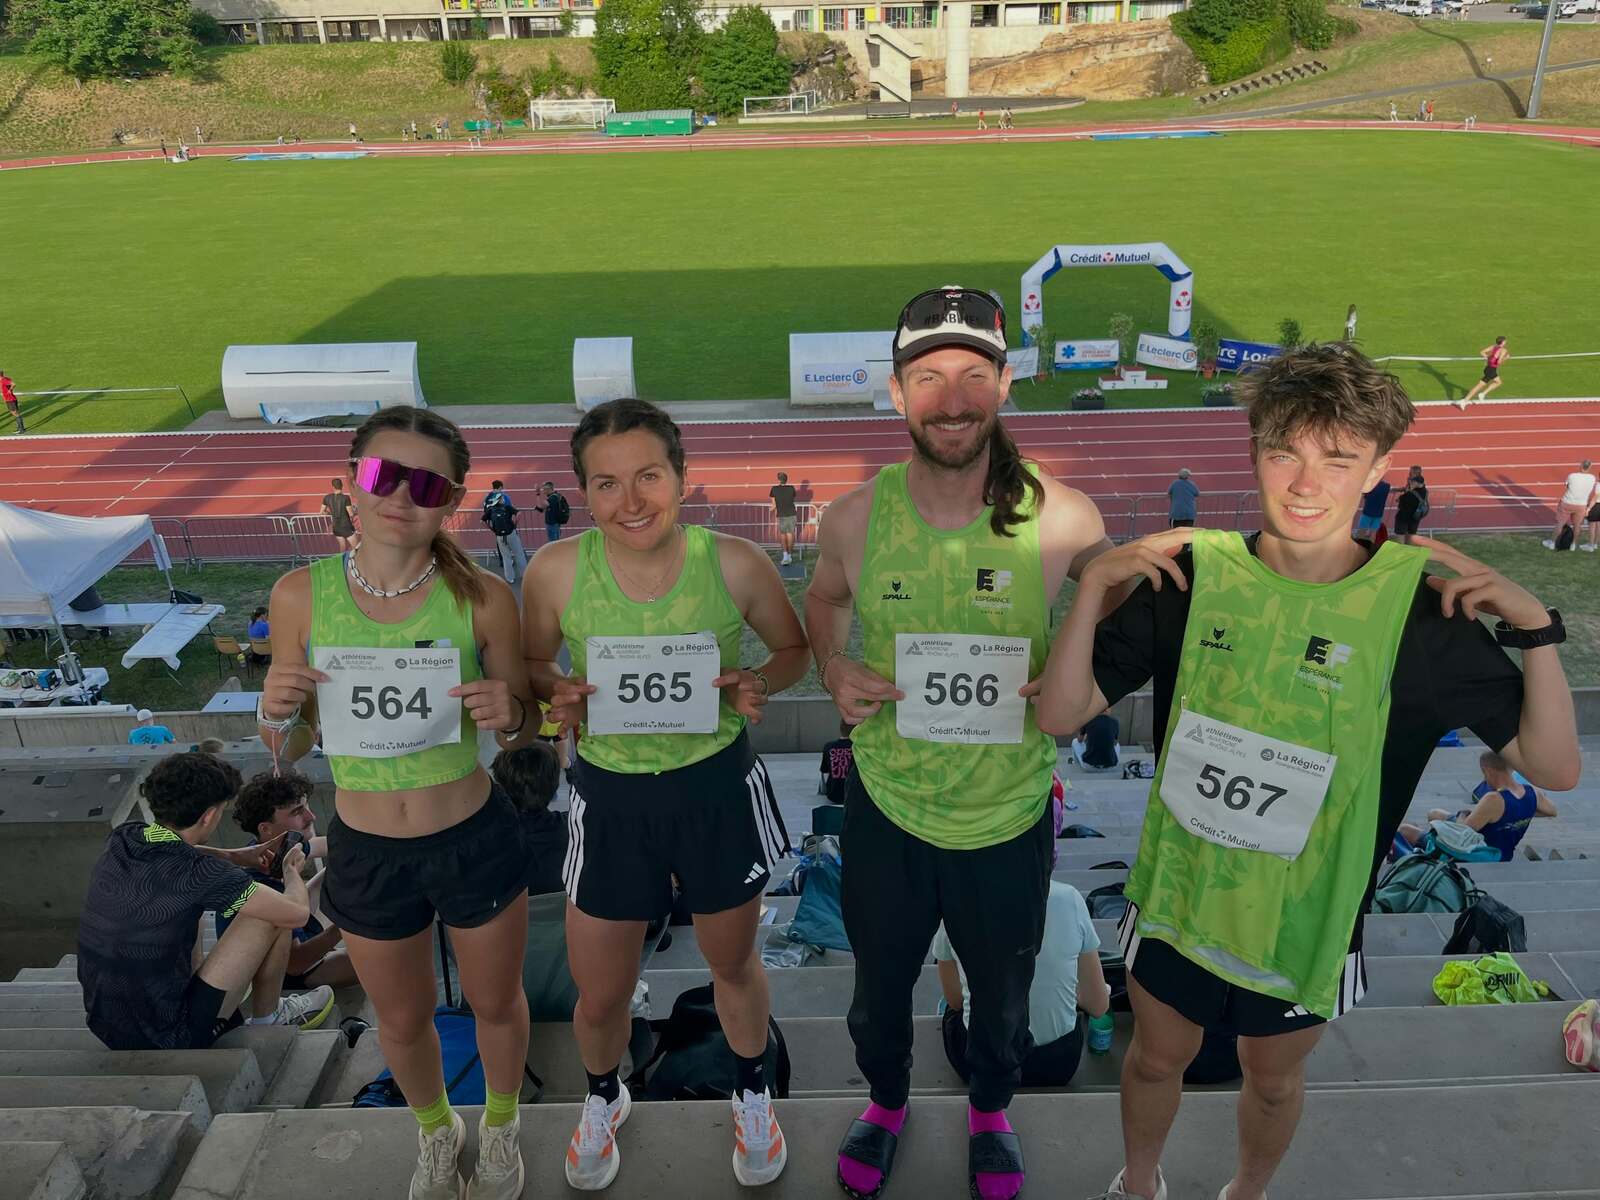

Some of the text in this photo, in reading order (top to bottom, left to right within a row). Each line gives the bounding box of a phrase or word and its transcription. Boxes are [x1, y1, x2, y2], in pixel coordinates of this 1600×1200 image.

[1070, 252, 1150, 264] Crédit Mutuel
[686, 644, 714, 652] Région
[983, 644, 1024, 653] La Région
[1199, 639, 1233, 652] SPALL
[410, 657, 454, 667] La Région
[617, 672, 692, 703] 565
[924, 672, 999, 707] 566
[351, 686, 432, 720] 564
[929, 726, 990, 736] Crédit Mutuel
[1206, 727, 1244, 744] athlétisme
[360, 739, 426, 751] Crédit Mutuel
[1277, 751, 1289, 762] La
[1290, 755, 1326, 773] Région
[1196, 763, 1288, 817] 567
[1190, 817, 1261, 850] Crédit Mutuel
